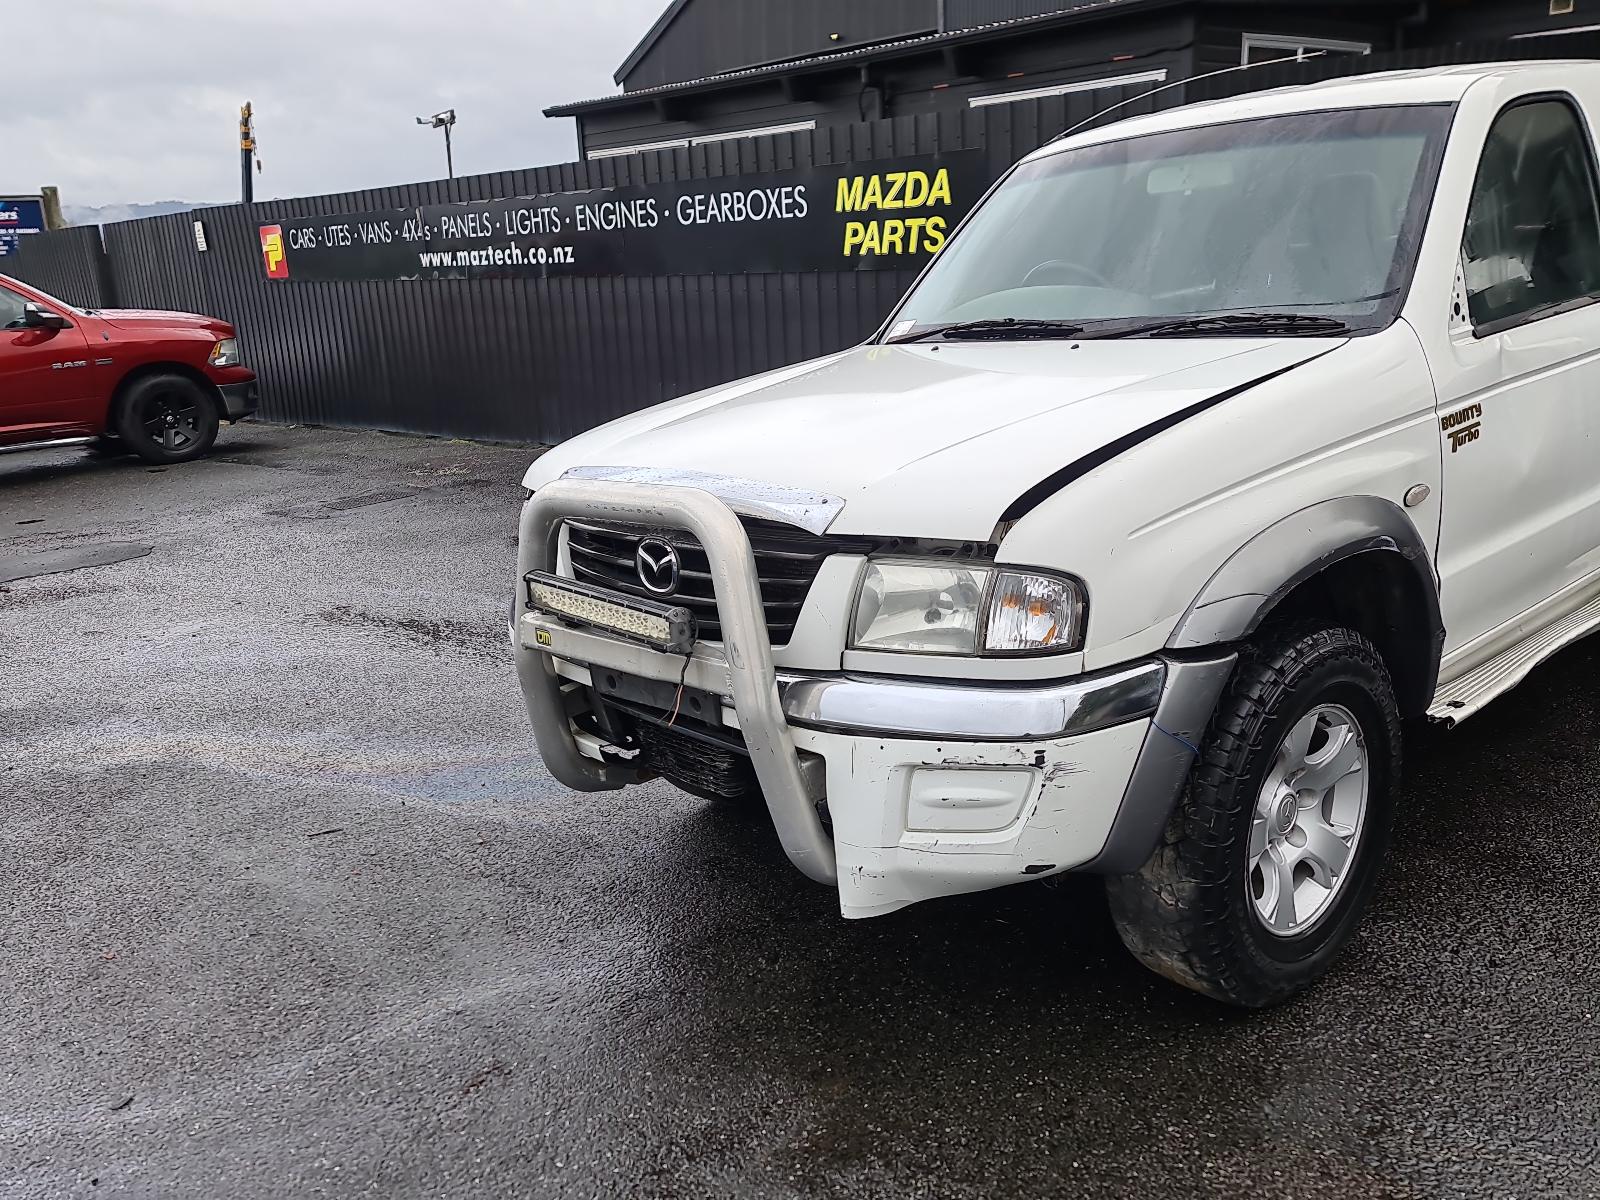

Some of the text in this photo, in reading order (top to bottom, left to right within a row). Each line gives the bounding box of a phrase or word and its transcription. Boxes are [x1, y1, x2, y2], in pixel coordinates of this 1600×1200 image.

[835, 168, 952, 214] MAZDA
[289, 228, 317, 250] CARS
[323, 224, 351, 247] UTES
[358, 220, 392, 245] VANS
[441, 211, 493, 240] PANELS
[504, 205, 561, 236] LIGHTS
[575, 198, 659, 233] ENGINES
[676, 184, 808, 227] GEARBOXES
[419, 242, 575, 267] www.maztech.co.nz
[842, 215, 947, 257] PARTS
[1441, 403, 1482, 431] BOUNTY
[1447, 421, 1481, 453] Turbo
